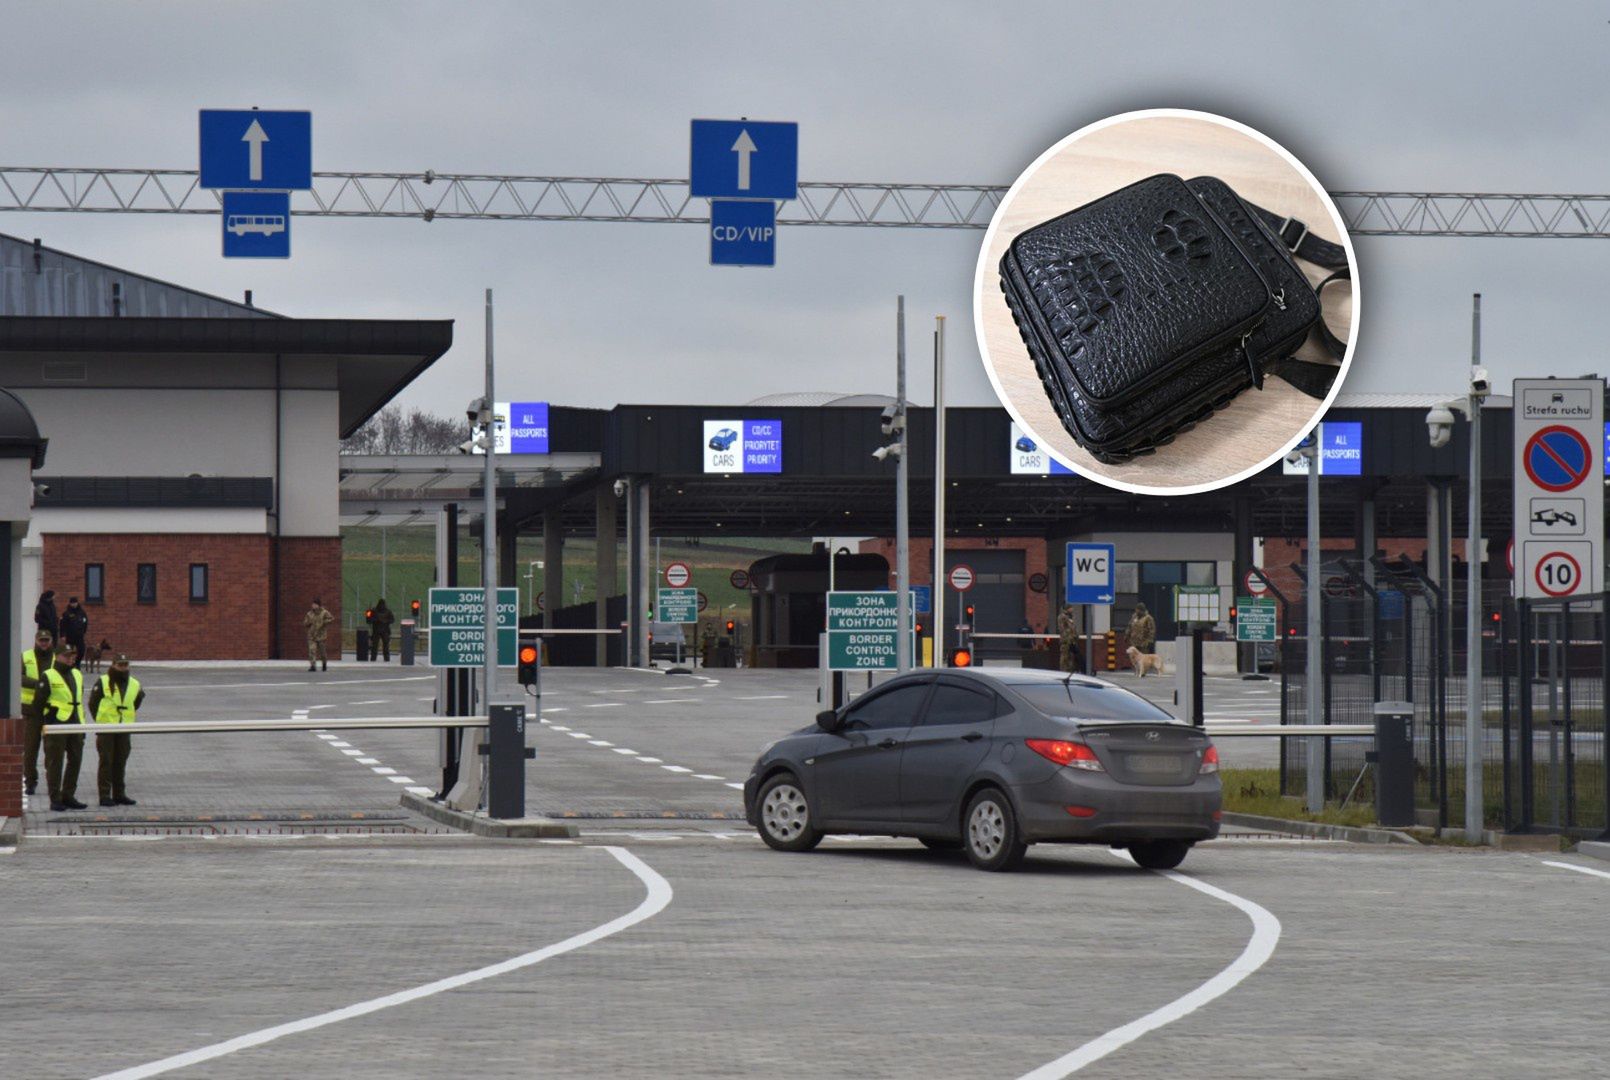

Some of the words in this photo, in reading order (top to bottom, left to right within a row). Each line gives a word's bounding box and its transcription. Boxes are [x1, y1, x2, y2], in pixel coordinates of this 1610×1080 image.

[713, 226, 773, 242] CD/VIP
[1526, 405, 1558, 415] Strefa
[1561, 405, 1590, 415] ruchu
[523, 414, 535, 425] ALL
[511, 428, 547, 438] PASSPORTS
[1335, 435, 1347, 445] ALL
[745, 440, 779, 451] PRIORYTET
[1323, 449, 1360, 459] PASSPORTS
[713, 454, 735, 467] CARS
[747, 454, 776, 465] PRIORITY
[1020, 455, 1041, 468] CARS
[1076, 558, 1106, 573] WC
[1544, 564, 1571, 585] 10
[856, 597, 885, 606] ЗОНА
[431, 604, 516, 614] ПРИКОРДООГО
[441, 615, 506, 624] КОНТРОЮ
[451, 631, 485, 641] BORD
[849, 635, 892, 644] BORDER
[448, 642, 486, 652] CONTR
[845, 646, 896, 655] CONTROL
[856, 657, 885, 666] ZONE
